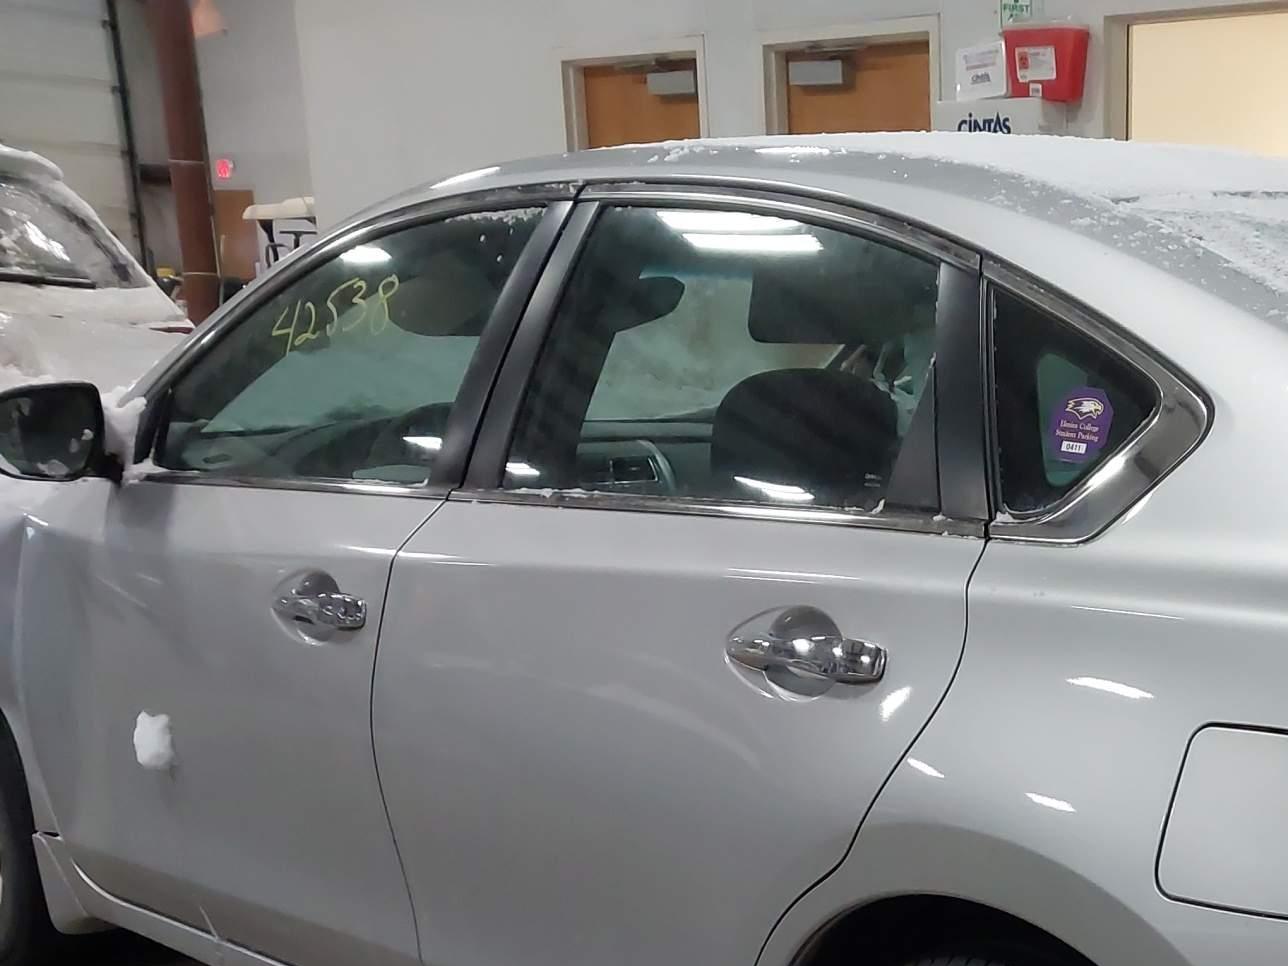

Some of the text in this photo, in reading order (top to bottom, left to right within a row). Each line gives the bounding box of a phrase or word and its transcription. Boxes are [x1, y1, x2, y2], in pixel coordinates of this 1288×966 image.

[1003, 3, 1030, 13] FIRST
[271, 273, 400, 357] 42538
[1079, 423, 1099, 432] College
[1078, 432, 1099, 442] Parking
